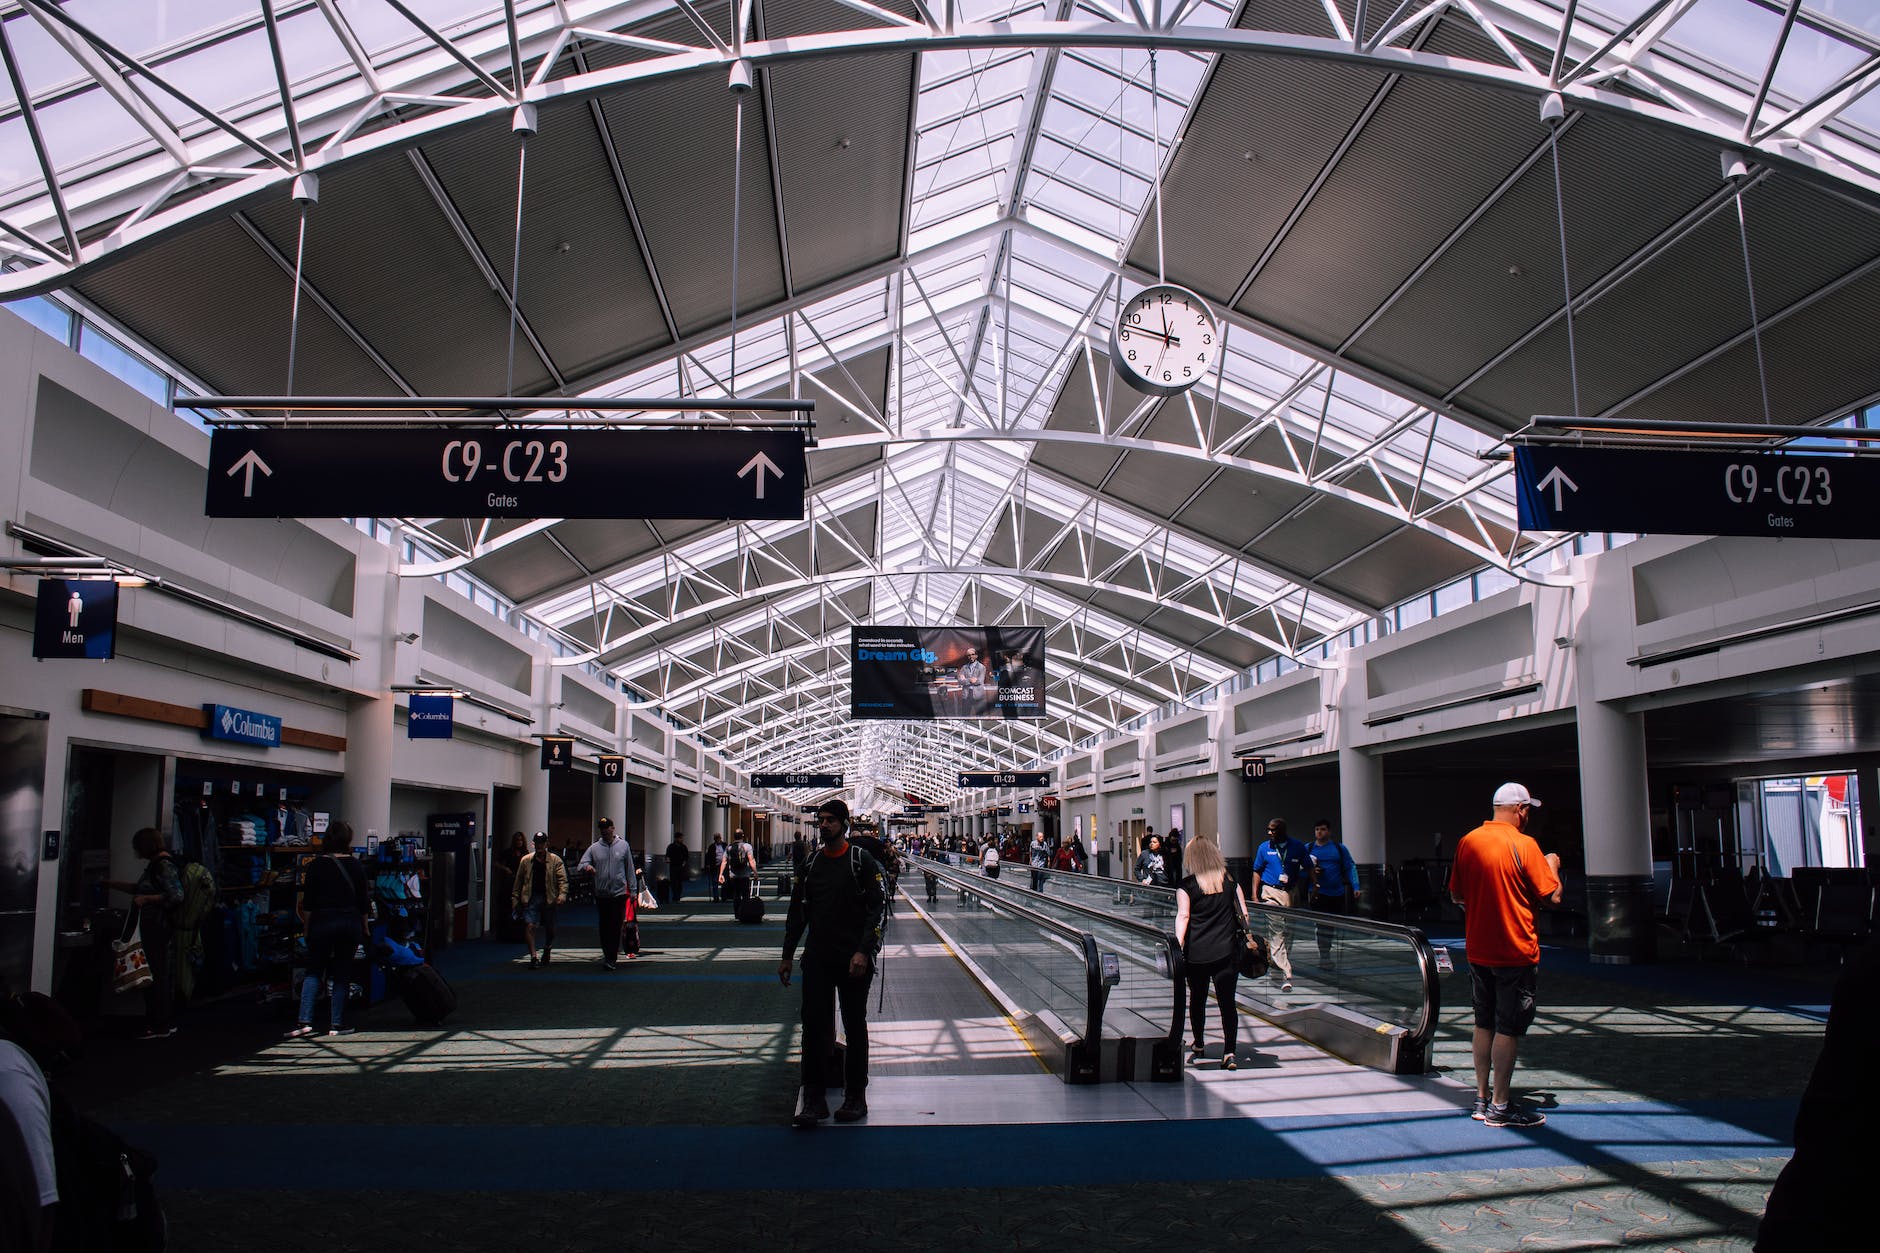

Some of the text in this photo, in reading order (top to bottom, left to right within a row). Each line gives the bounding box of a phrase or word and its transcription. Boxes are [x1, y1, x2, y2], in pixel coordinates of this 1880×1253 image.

[1140, 299, 1151, 310] 11
[1159, 294, 1172, 305] 12
[1183, 301, 1189, 311] 1
[1126, 313, 1141, 325] 10
[1197, 314, 1205, 326] 2
[1121, 330, 1130, 341] 9
[1202, 334, 1212, 345] 3
[1127, 349, 1137, 361] 8
[1197, 352, 1206, 363] 4
[1143, 366, 1152, 376] 7
[1163, 371, 1172, 382] 6
[1183, 366, 1192, 377] 5
[441, 440, 569, 483] C9-C23
[1724, 464, 1833, 506] C9-C23
[487, 492, 518, 508] Gates
[1767, 513, 1795, 528] Gates
[62, 630, 84, 644] Men
[858, 647, 939, 664] Dream Gig.
[999, 687, 1035, 695] COMCAST
[417, 712, 450, 720] Columbia
[232, 712, 276, 741] Columbia
[604, 762, 618, 777] C9
[1245, 763, 1264, 777] C10
